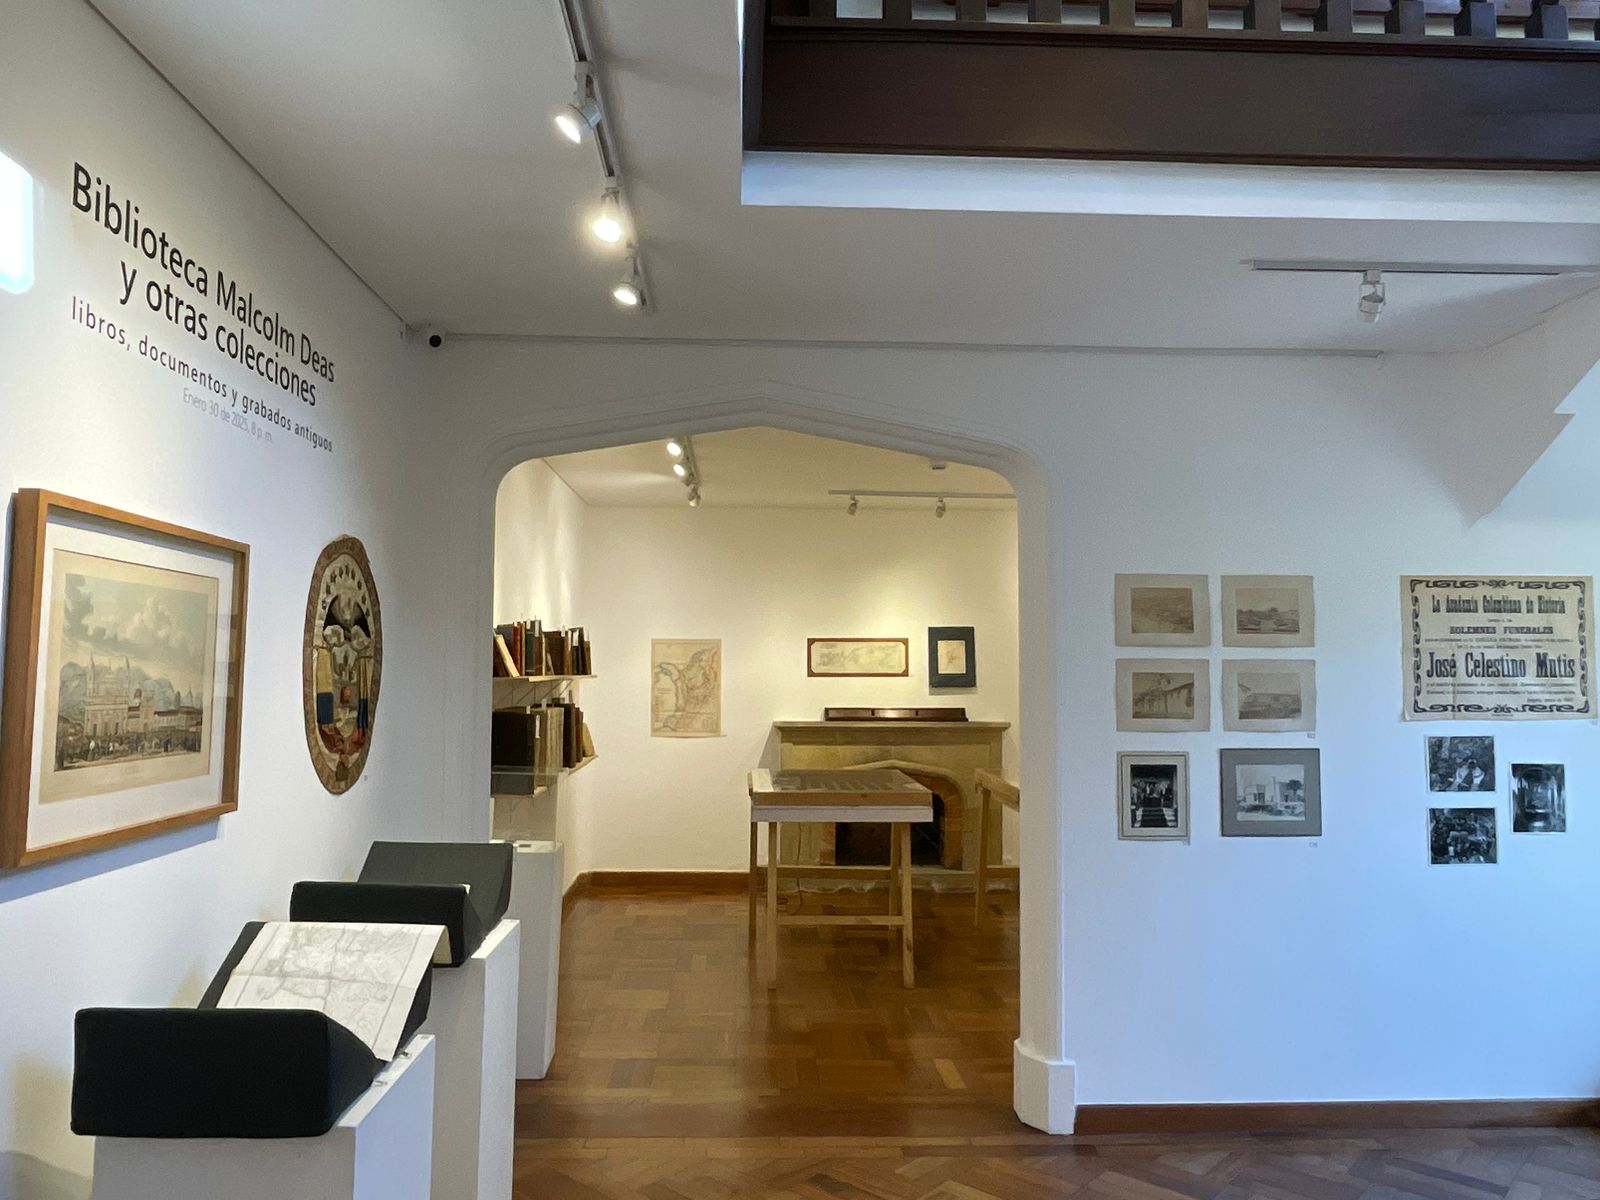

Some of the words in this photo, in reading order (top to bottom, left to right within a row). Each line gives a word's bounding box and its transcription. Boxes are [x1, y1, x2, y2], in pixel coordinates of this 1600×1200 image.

[72, 161, 208, 297] Biblioteca
[217, 270, 295, 357] Malcolm
[300, 333, 335, 383] Deas
[120, 260, 137, 305] y
[146, 280, 208, 341] otras
[215, 325, 316, 407] colecciones
[71, 295, 131, 351] libros,
[138, 335, 228, 398] documentos
[231, 388, 238, 408] y
[242, 394, 292, 431] grabados
[294, 423, 334, 453] antiguos
[183, 387, 207, 412] Enero
[208, 399, 219, 417] 30
[220, 407, 231, 423] de
[1426, 652, 1457, 678] José
[1465, 652, 1527, 678] Celestino
[1535, 652, 1576, 678] Mutis
